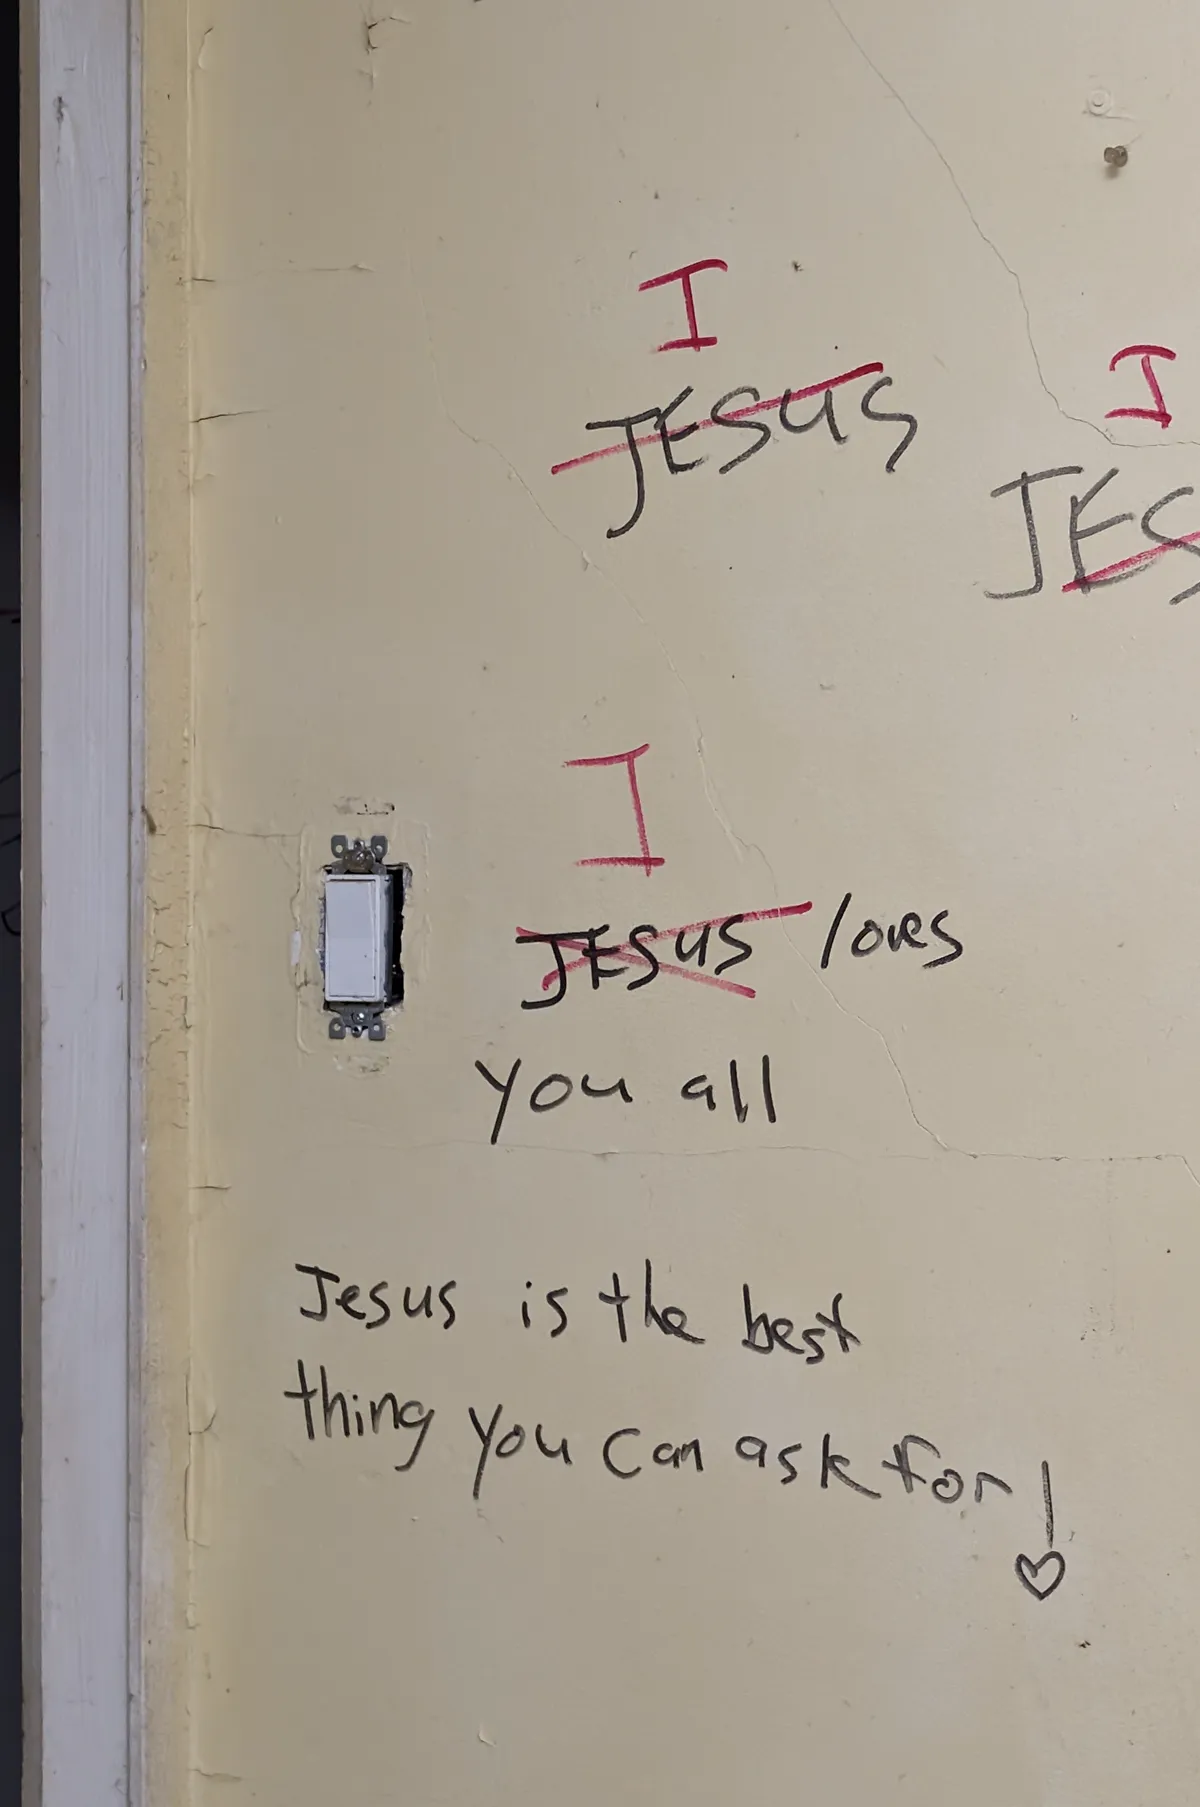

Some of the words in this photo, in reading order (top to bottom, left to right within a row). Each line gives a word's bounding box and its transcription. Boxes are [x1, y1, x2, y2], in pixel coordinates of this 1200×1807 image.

[638, 258, 728, 352] I
[1106, 345, 1176, 429] I
[563, 743, 666, 877] I
[821, 892, 964, 970] loves
[681, 1055, 777, 1124] all
[295, 1264, 456, 1329] Jesus
[522, 1281, 569, 1338] is
[599, 1259, 705, 1344] the
[742, 1283, 861, 1364] best
[284, 1359, 435, 1472] thing
[735, 1433, 882, 1500] ask
